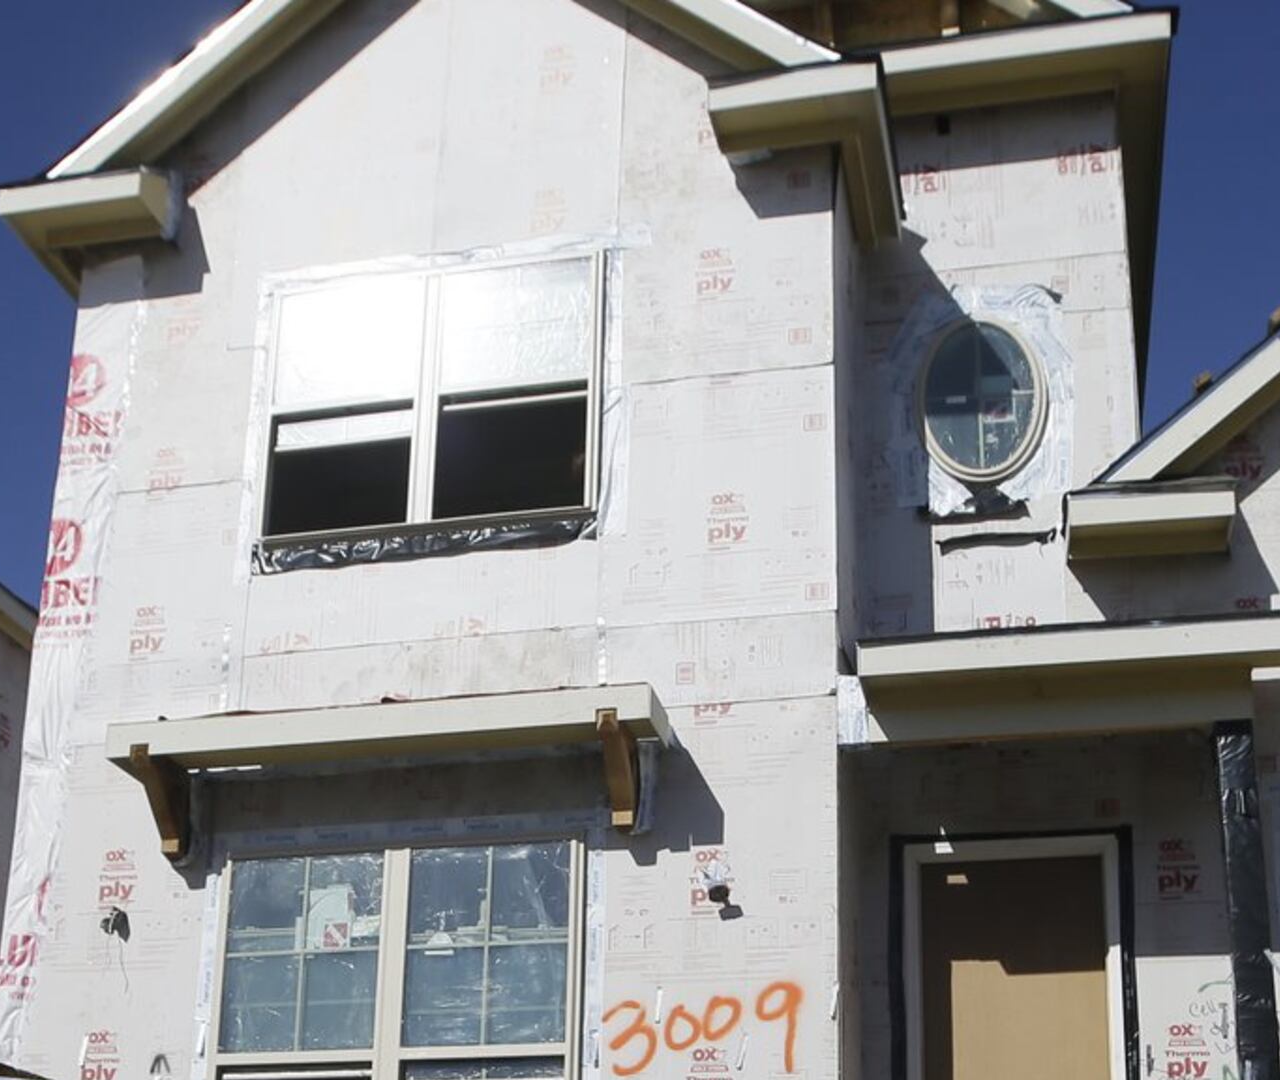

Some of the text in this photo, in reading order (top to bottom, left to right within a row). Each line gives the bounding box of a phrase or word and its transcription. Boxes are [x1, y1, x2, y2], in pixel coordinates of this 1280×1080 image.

[696, 274, 733, 295] ply
[47, 523, 76, 562] 4
[708, 523, 748, 542] ply
[130, 634, 167, 654] ply
[99, 881, 135, 901] ply
[1158, 869, 1200, 894] ply
[601, 981, 804, 1077] 3009
[1167, 1057, 1209, 1077] ply
